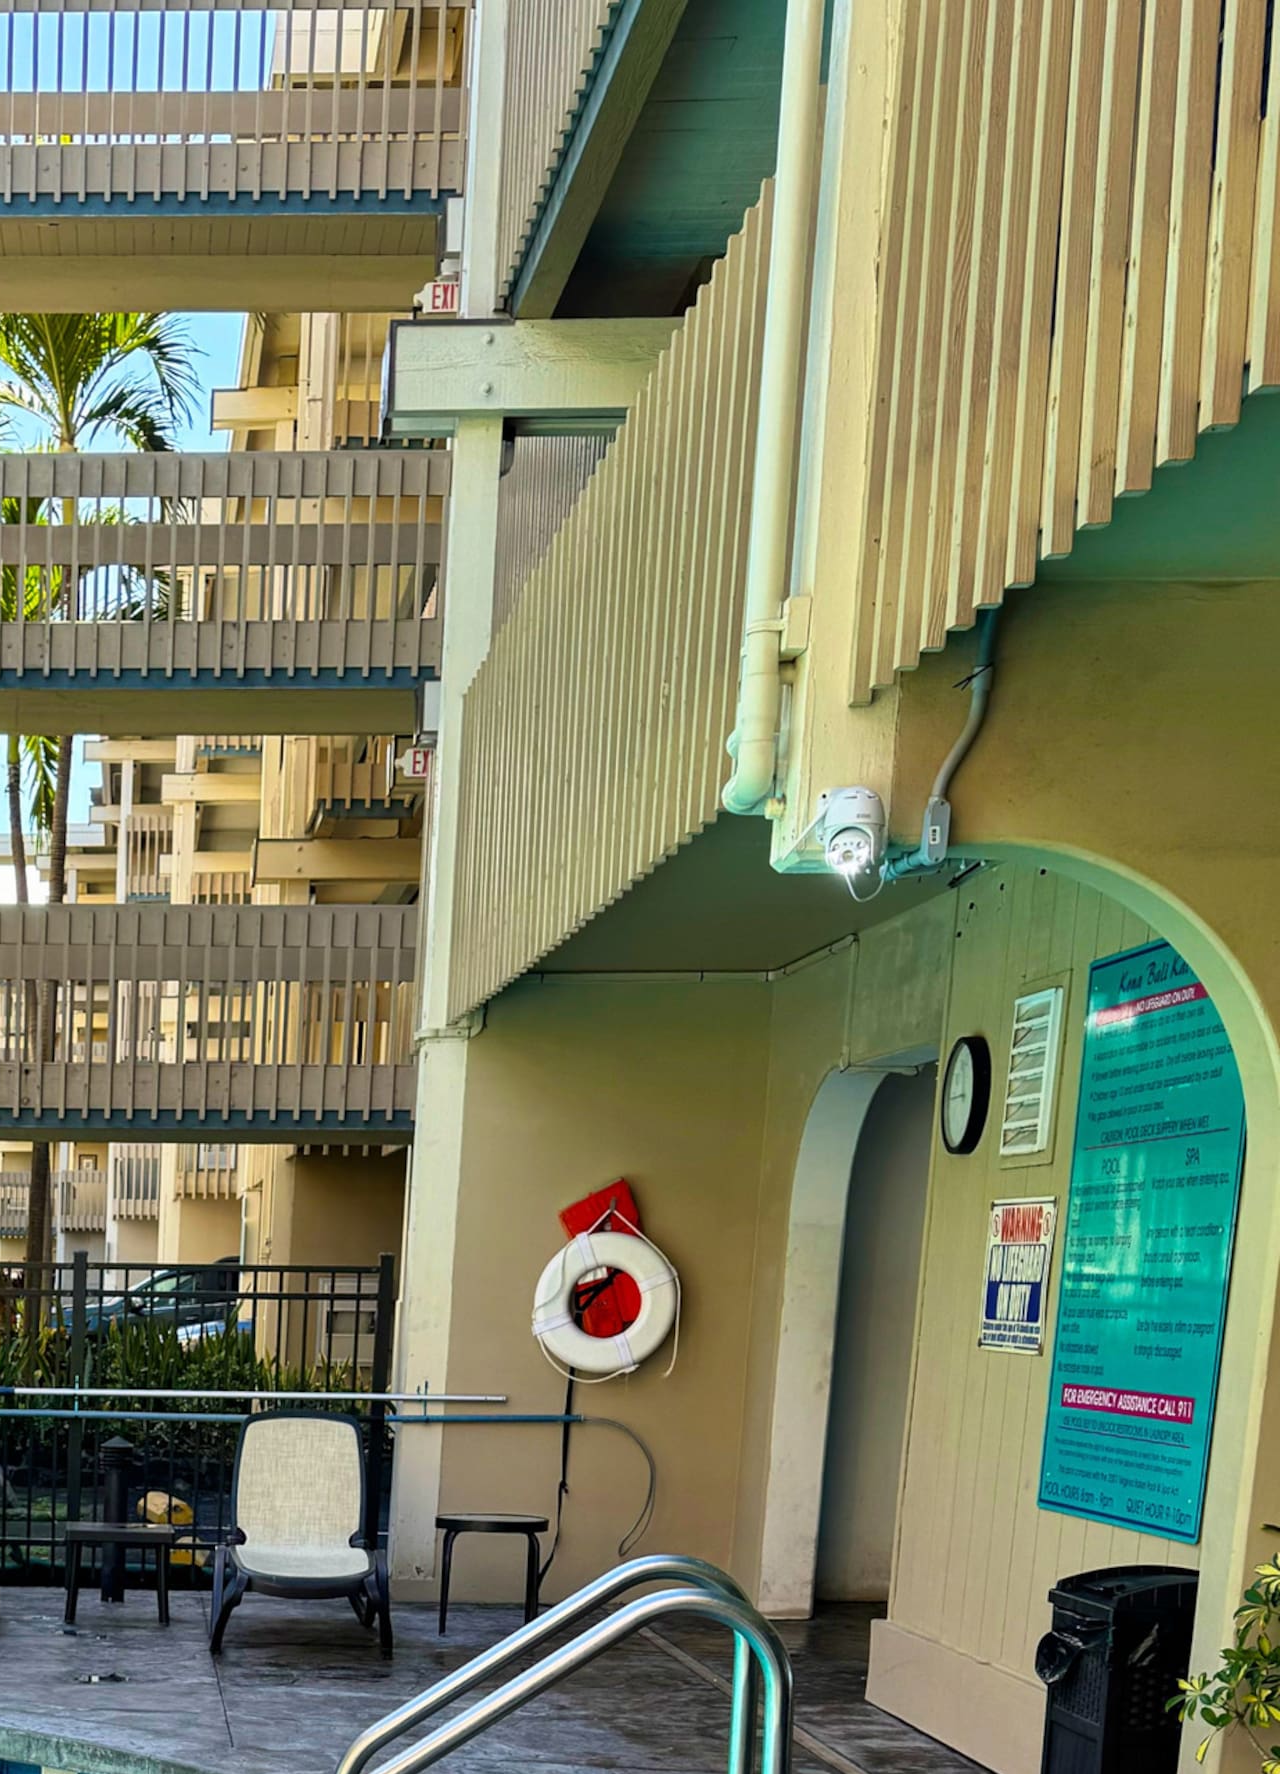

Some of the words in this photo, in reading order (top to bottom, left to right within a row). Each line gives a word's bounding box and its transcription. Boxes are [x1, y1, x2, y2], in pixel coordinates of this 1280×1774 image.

[432, 284, 459, 310] EXI
[1145, 993, 1172, 1012] LIFEGUARD
[1172, 990, 1182, 1004] ON
[1102, 1158, 1122, 1176] POOL
[1185, 1147, 1201, 1166] SPA
[1001, 1206, 1043, 1243] WARNING
[990, 1245, 1004, 1281] NO
[1002, 1245, 1046, 1282] LIFEGUARD
[996, 1283, 1010, 1320] ON
[1008, 1284, 1032, 1320] DUTY
[1063, 1387, 1077, 1404] FOR
[1077, 1389, 1117, 1409] EMERGENCY
[1117, 1393, 1158, 1414] ASSISTANCE
[1157, 1397, 1177, 1416] CALL
[1177, 1399, 1193, 1418] 911
[1044, 1481, 1060, 1496] POOL
[1061, 1484, 1080, 1501] HOURS
[1126, 1498, 1144, 1515] QUIET
